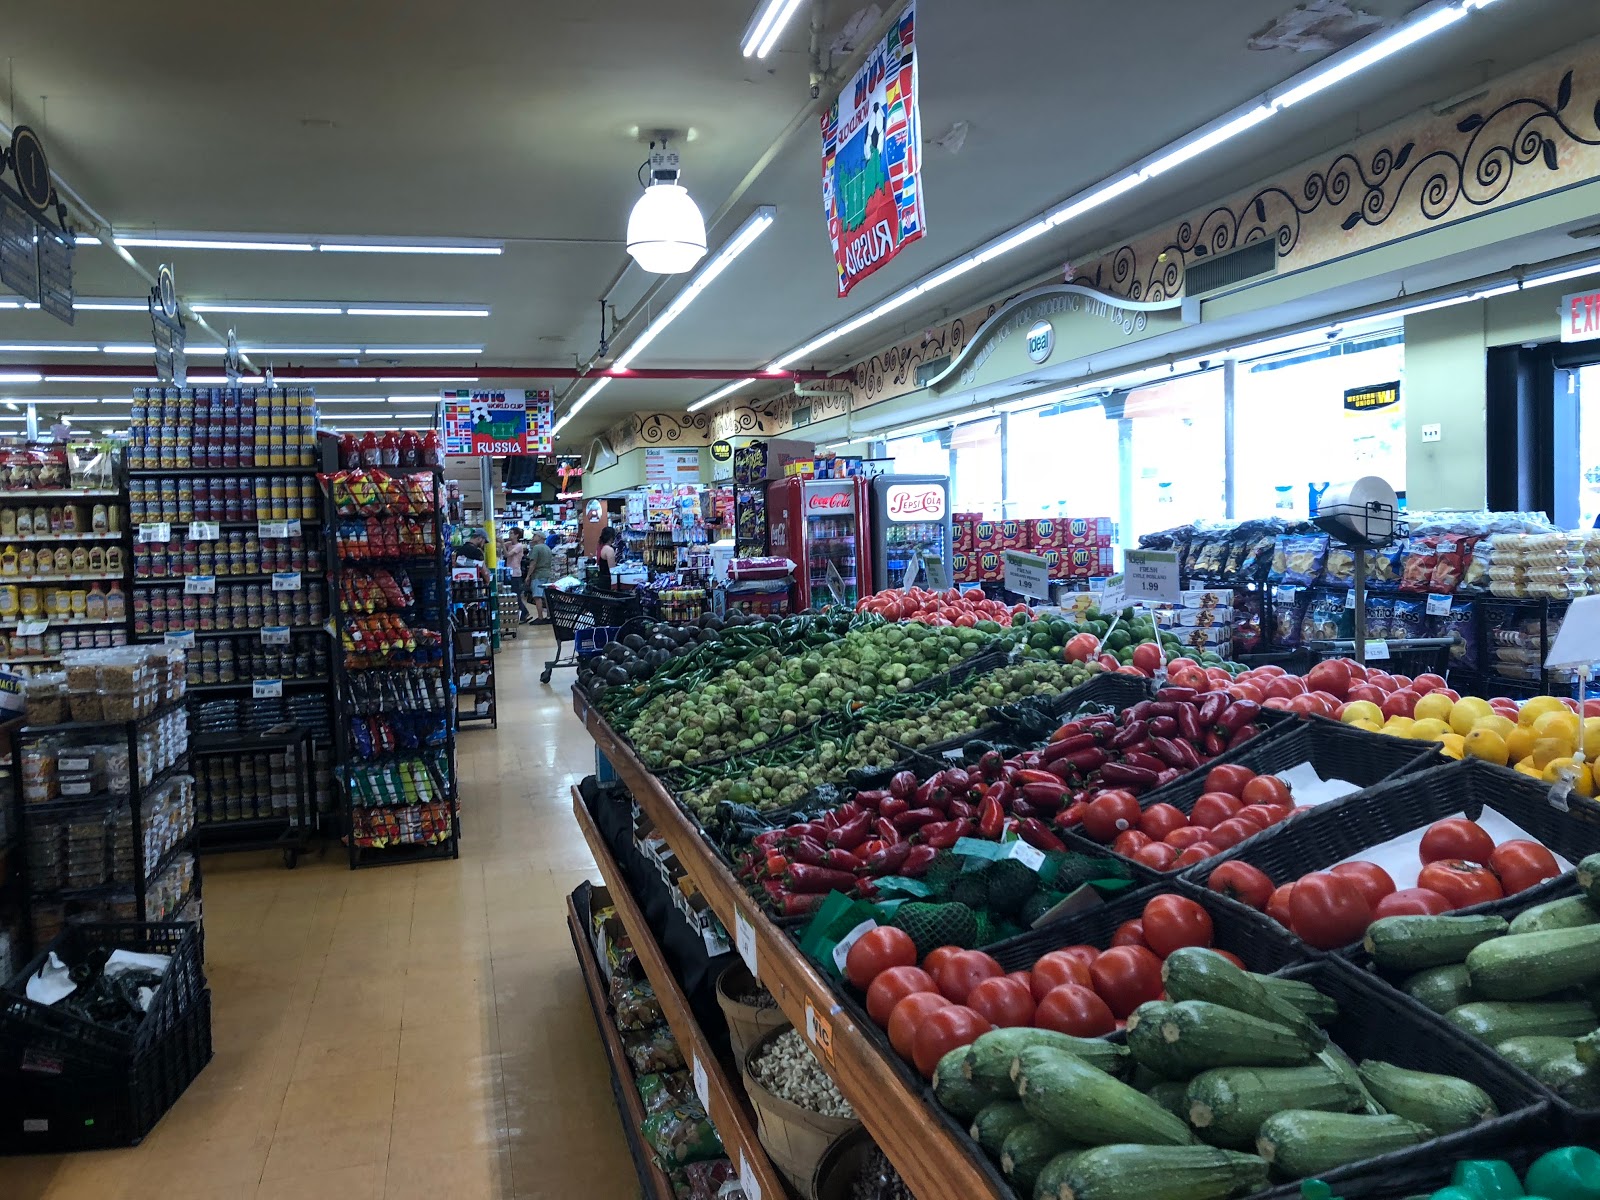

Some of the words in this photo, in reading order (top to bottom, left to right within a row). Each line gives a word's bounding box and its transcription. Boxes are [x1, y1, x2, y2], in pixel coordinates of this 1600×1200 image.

[1015, 307, 1032, 328] FOR
[1035, 295, 1080, 318] SHOPPING
[1084, 297, 1107, 318] WITH
[1110, 305, 1124, 325] US
[1571, 293, 1600, 334] EXI
[1028, 330, 1049, 354] ideal
[1347, 393, 1375, 402] WESTERN
[1376, 389, 1396, 405] WU
[1355, 399, 1375, 407] UNION
[477, 442, 522, 453] RUSSIA
[953, 523, 962, 538] ITZ
[976, 523, 994, 538] RITZ
[1003, 522, 1018, 537] RITZ
[1036, 520, 1053, 536] RITZ
[1070, 520, 1087, 535] RITZ
[953, 554, 968, 569] RITZ
[981, 553, 998, 569] RITZ
[1073, 550, 1089, 565] RITZ
[1018, 580, 1032, 588] 1.99
[1142, 582, 1158, 591] 1.99
